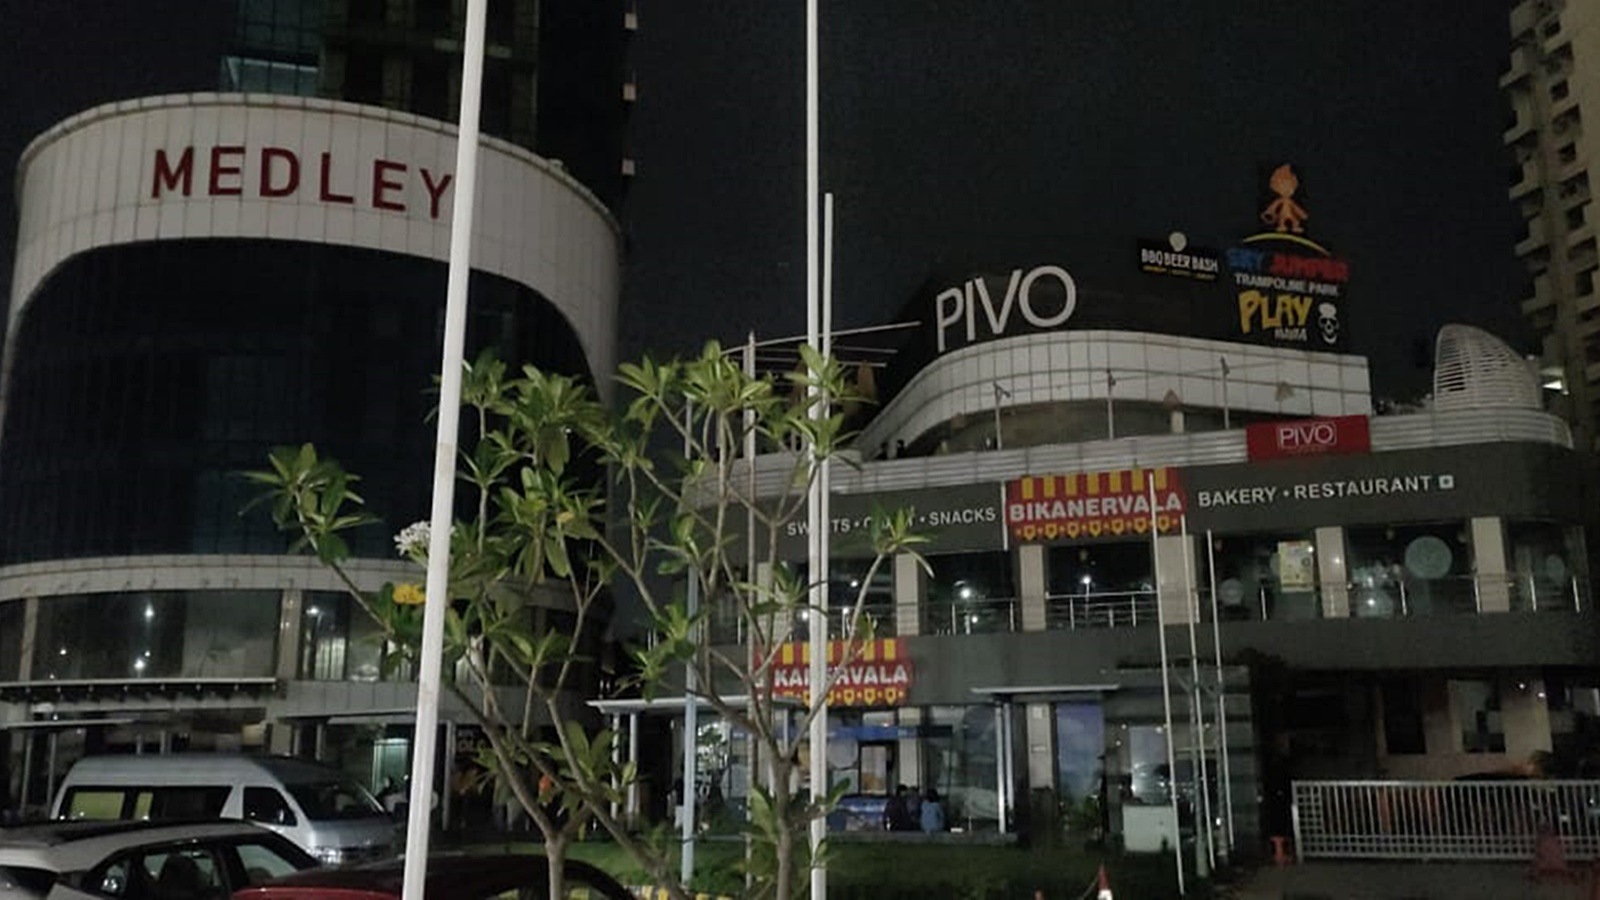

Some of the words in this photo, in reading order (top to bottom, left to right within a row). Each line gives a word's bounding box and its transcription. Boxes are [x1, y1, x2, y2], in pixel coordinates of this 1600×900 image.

[152, 146, 452, 219] MEDLEY
[1164, 251, 1191, 269] BEER
[1234, 272, 1308, 293] TRAMPOLINE
[936, 265, 1077, 353] PIVO
[1238, 289, 1313, 334] PLAY
[1280, 424, 1334, 447] PIVO
[1009, 491, 1182, 522] BIKANERVALA
[1198, 486, 1277, 507] BAKERY
[1294, 475, 1432, 499] RESTAURANT
[787, 517, 851, 537] SWTS
[928, 507, 996, 527] SNACKS
